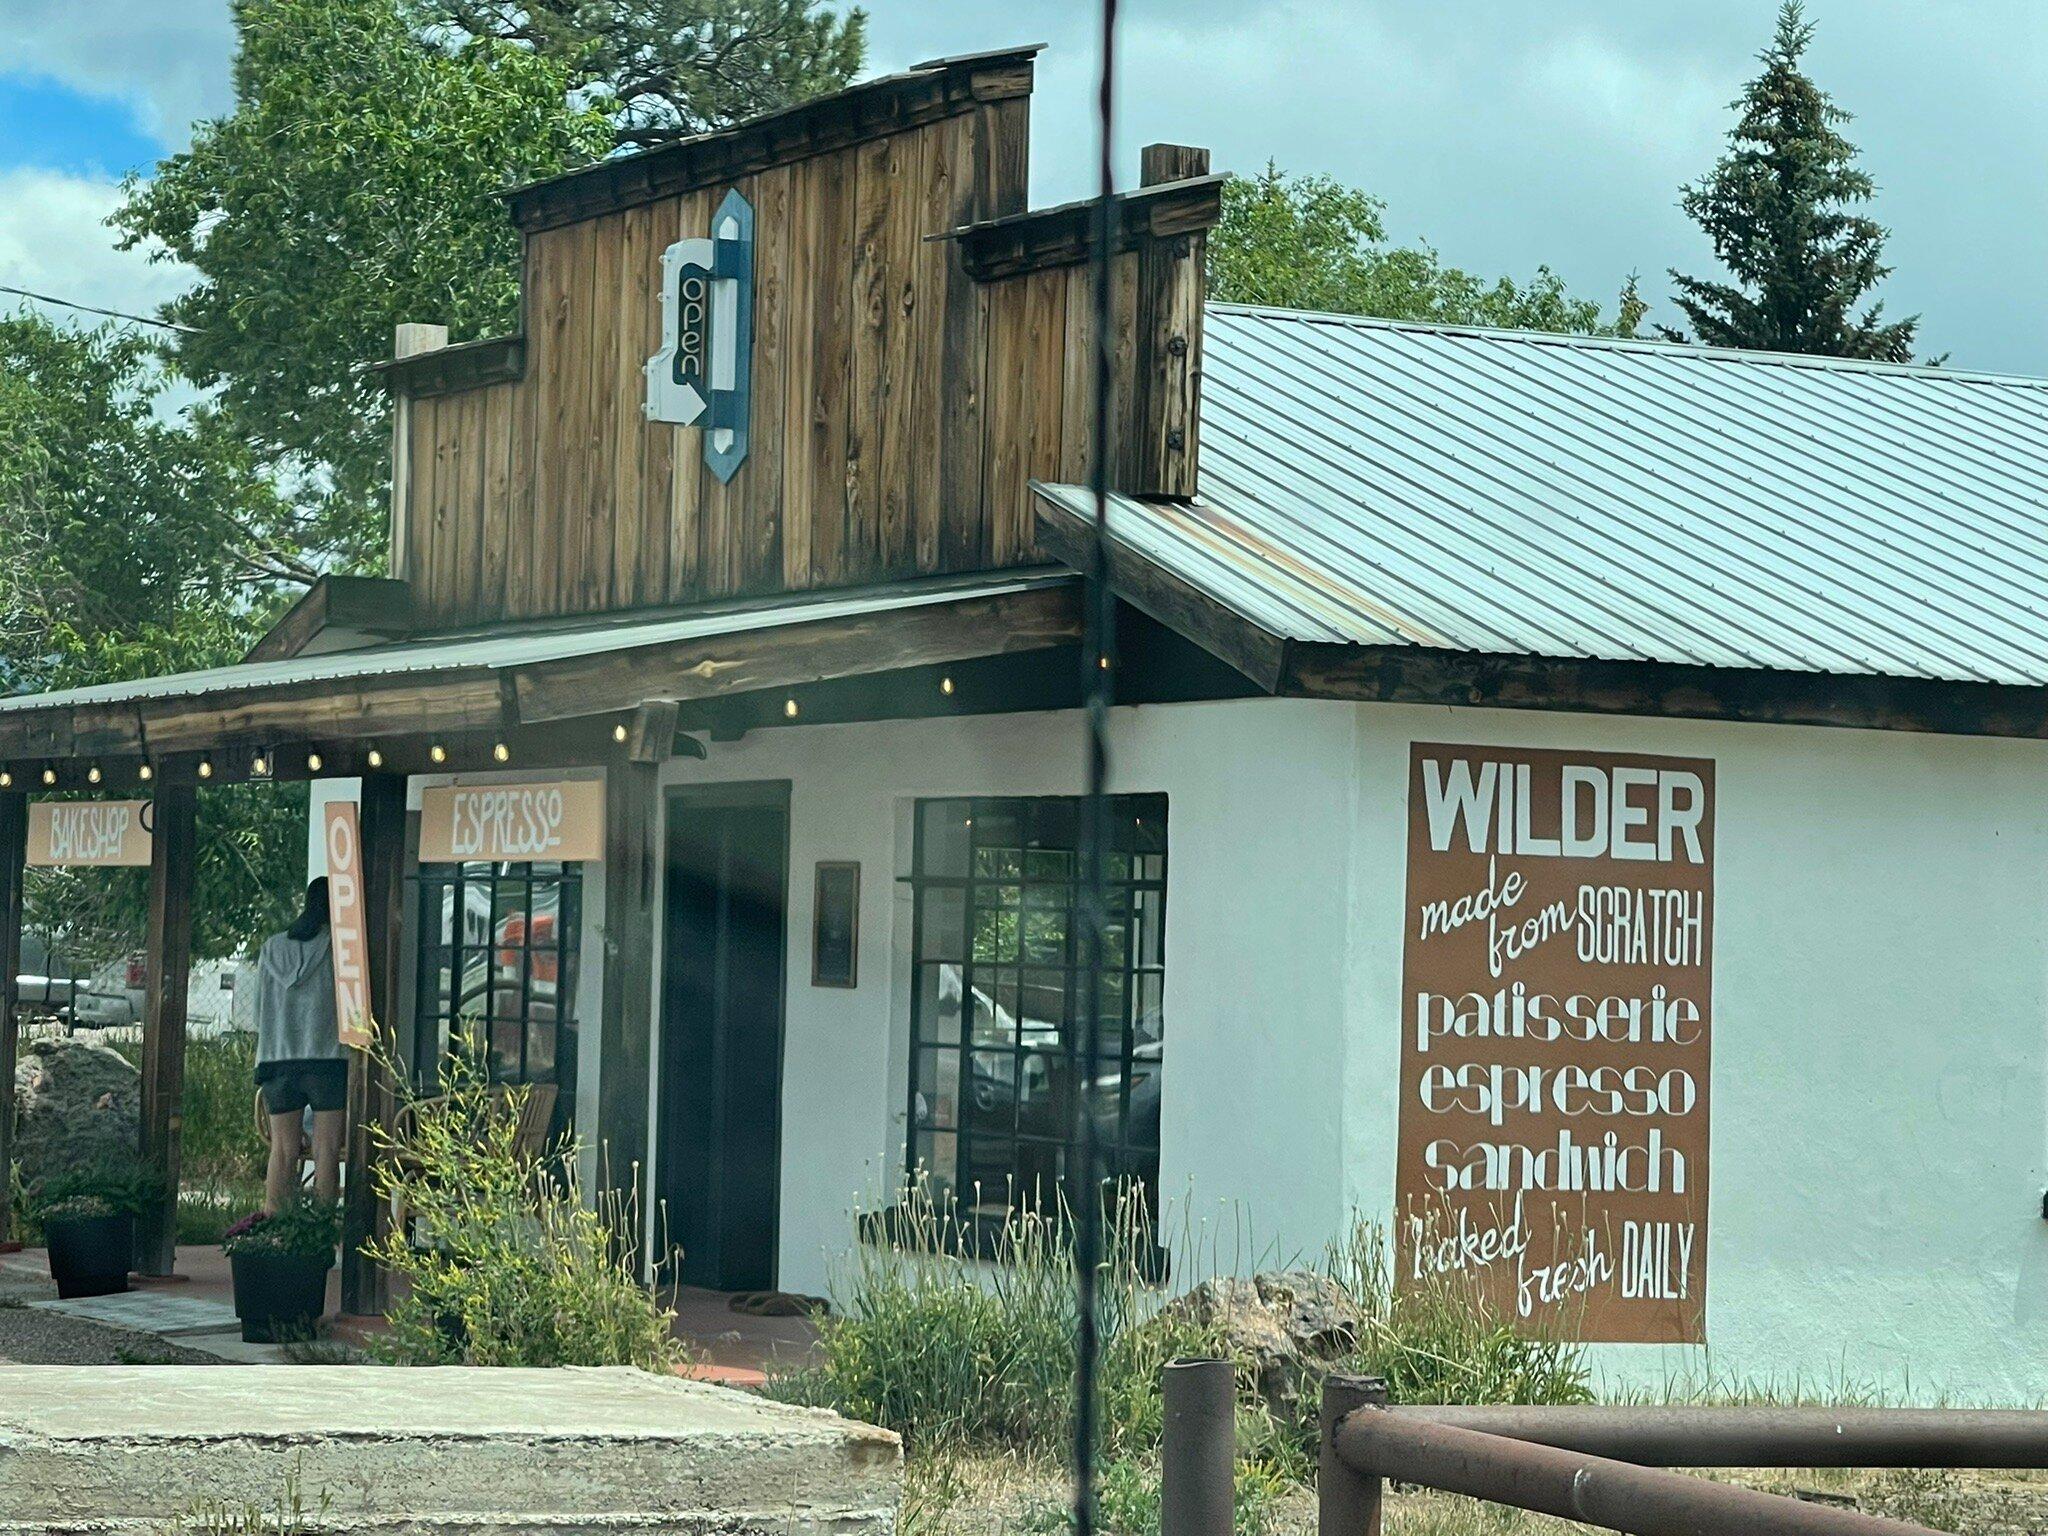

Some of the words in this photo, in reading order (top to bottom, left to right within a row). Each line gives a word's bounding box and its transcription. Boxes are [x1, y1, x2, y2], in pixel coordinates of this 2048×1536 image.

[682, 277, 703, 376] open
[50, 806, 130, 859] BAKESHOP
[451, 789, 562, 854] ESPRESSO
[1422, 759, 1705, 864] WILDER
[329, 816, 364, 1032] OPEN
[1420, 854, 1528, 940] made
[1489, 901, 1577, 978] from
[1577, 885, 1703, 966] SCRATCH
[1417, 981, 1702, 1051] patisserie
[1419, 1064, 1696, 1125] espresso
[1424, 1128, 1685, 1193] sandwich
[1517, 1228, 1616, 1318] fresh
[1622, 1221, 1694, 1299] DAILY
